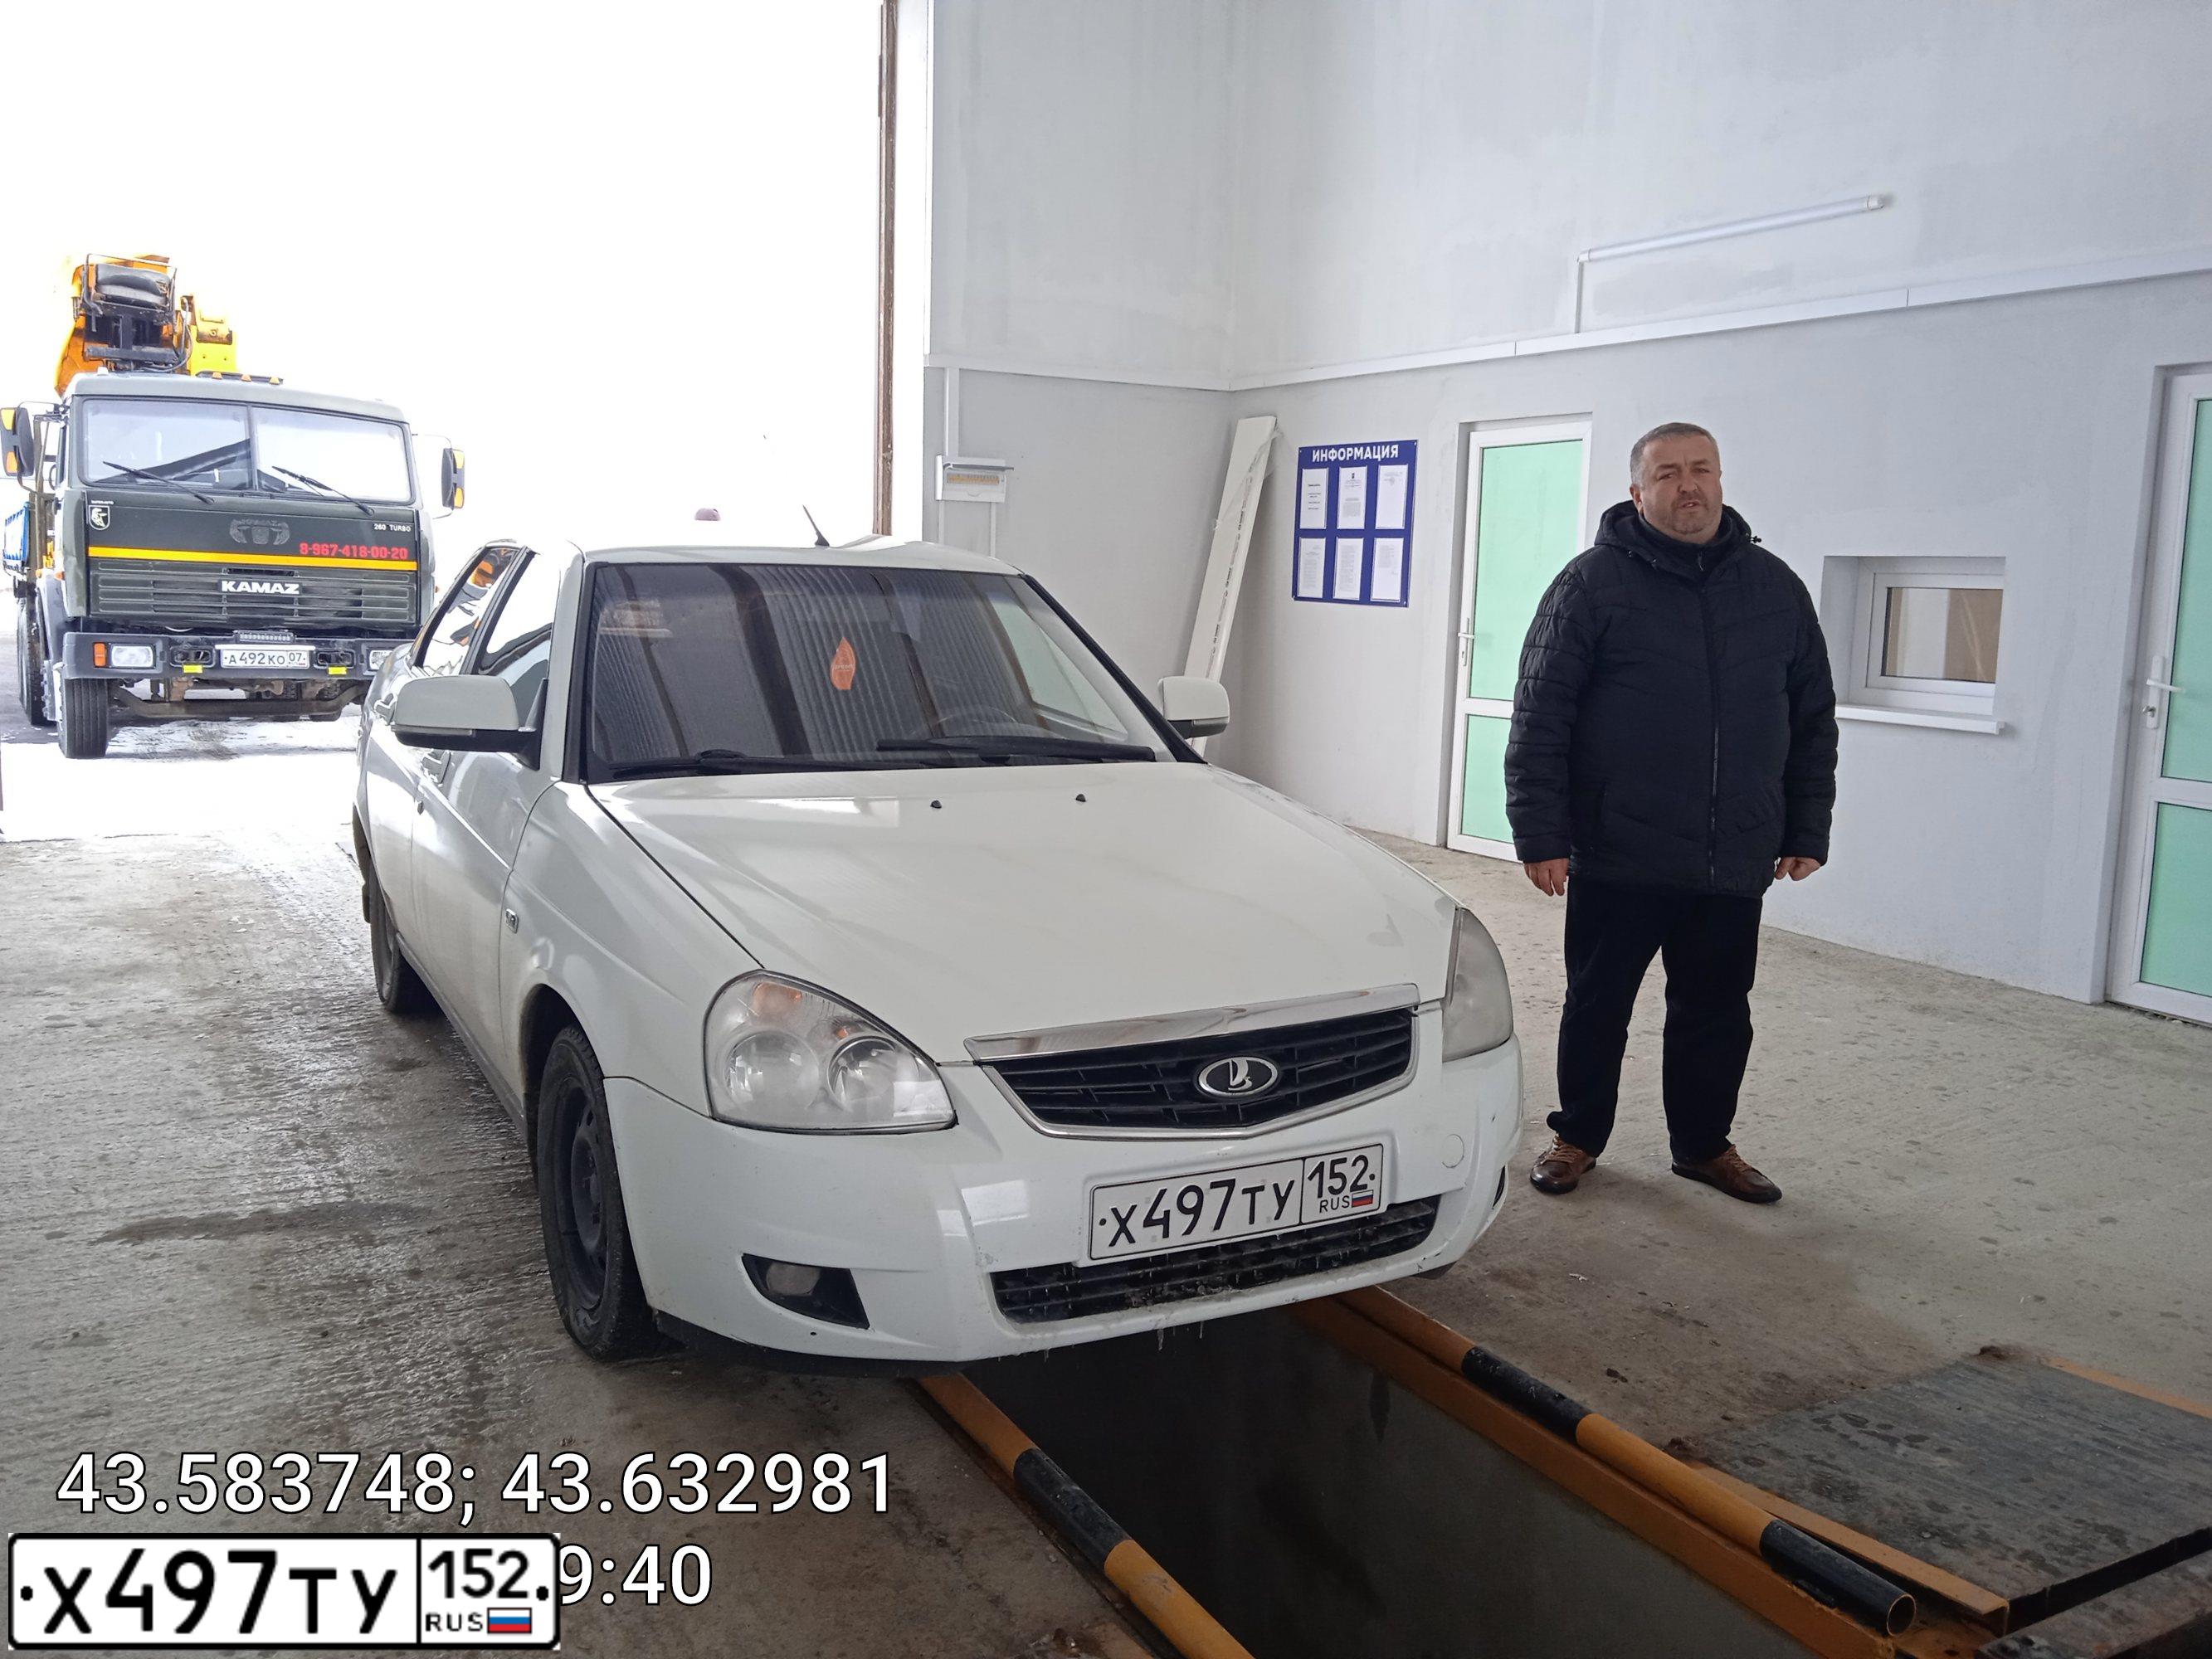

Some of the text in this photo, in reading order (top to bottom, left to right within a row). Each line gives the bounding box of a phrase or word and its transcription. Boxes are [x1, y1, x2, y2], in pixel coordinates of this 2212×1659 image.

[1312, 445, 1399, 463] ИНФОРМАЦИЯ
[389, 524, 412, 533] TURBO
[299, 542, 409, 560] 8-967-418-00-20
[222, 581, 300, 595] KAMAZ
[288, 652, 302, 662] 07
[1108, 1154, 1368, 1248] Х497ТУ 152
[1318, 1195, 1351, 1214] RUS
